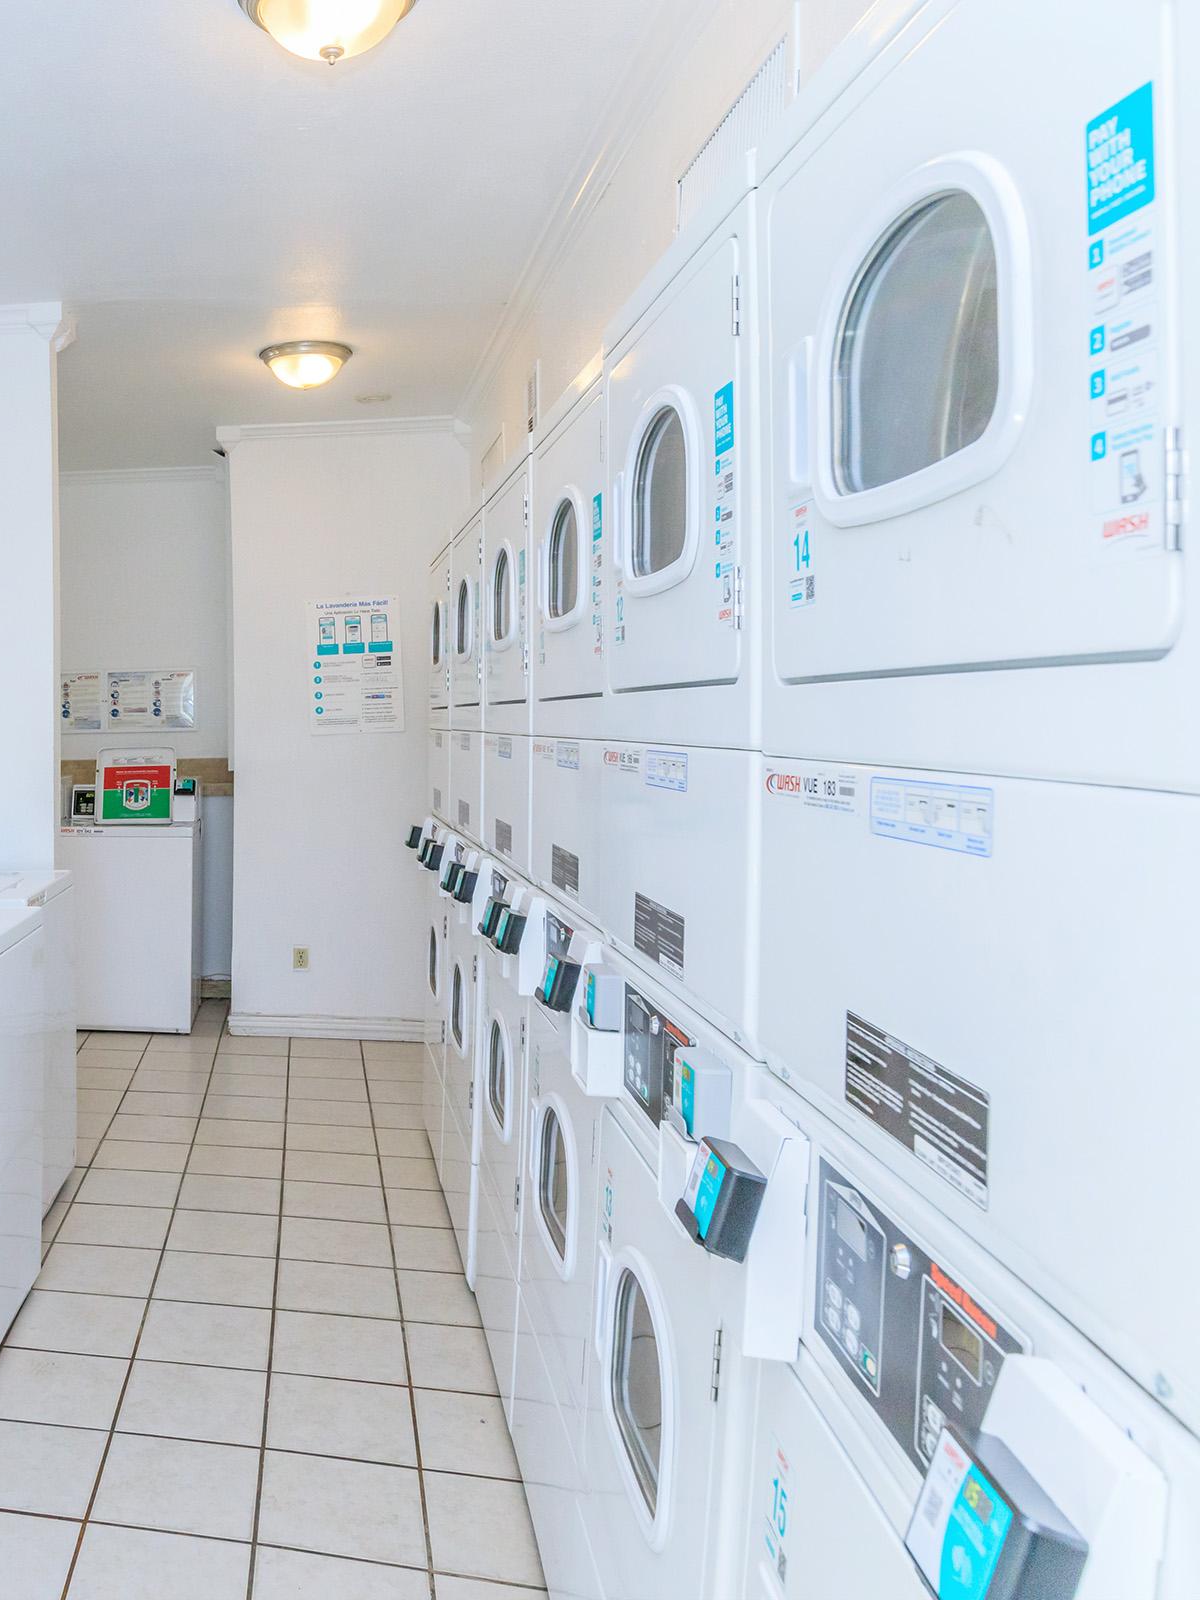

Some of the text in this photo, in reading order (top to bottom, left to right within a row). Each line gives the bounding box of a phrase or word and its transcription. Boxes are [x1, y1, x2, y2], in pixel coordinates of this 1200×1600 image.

[1089, 115, 1118, 150] PAY
[1089, 127, 1132, 169] WITH
[1089, 147, 1135, 187] YOUR
[1090, 159, 1147, 208] PHONE
[1103, 513, 1149, 538] WASH
[793, 530, 810, 571] 14
[777, 774, 836, 796] WASH VUE 183
[773, 1478, 787, 1537] 15
